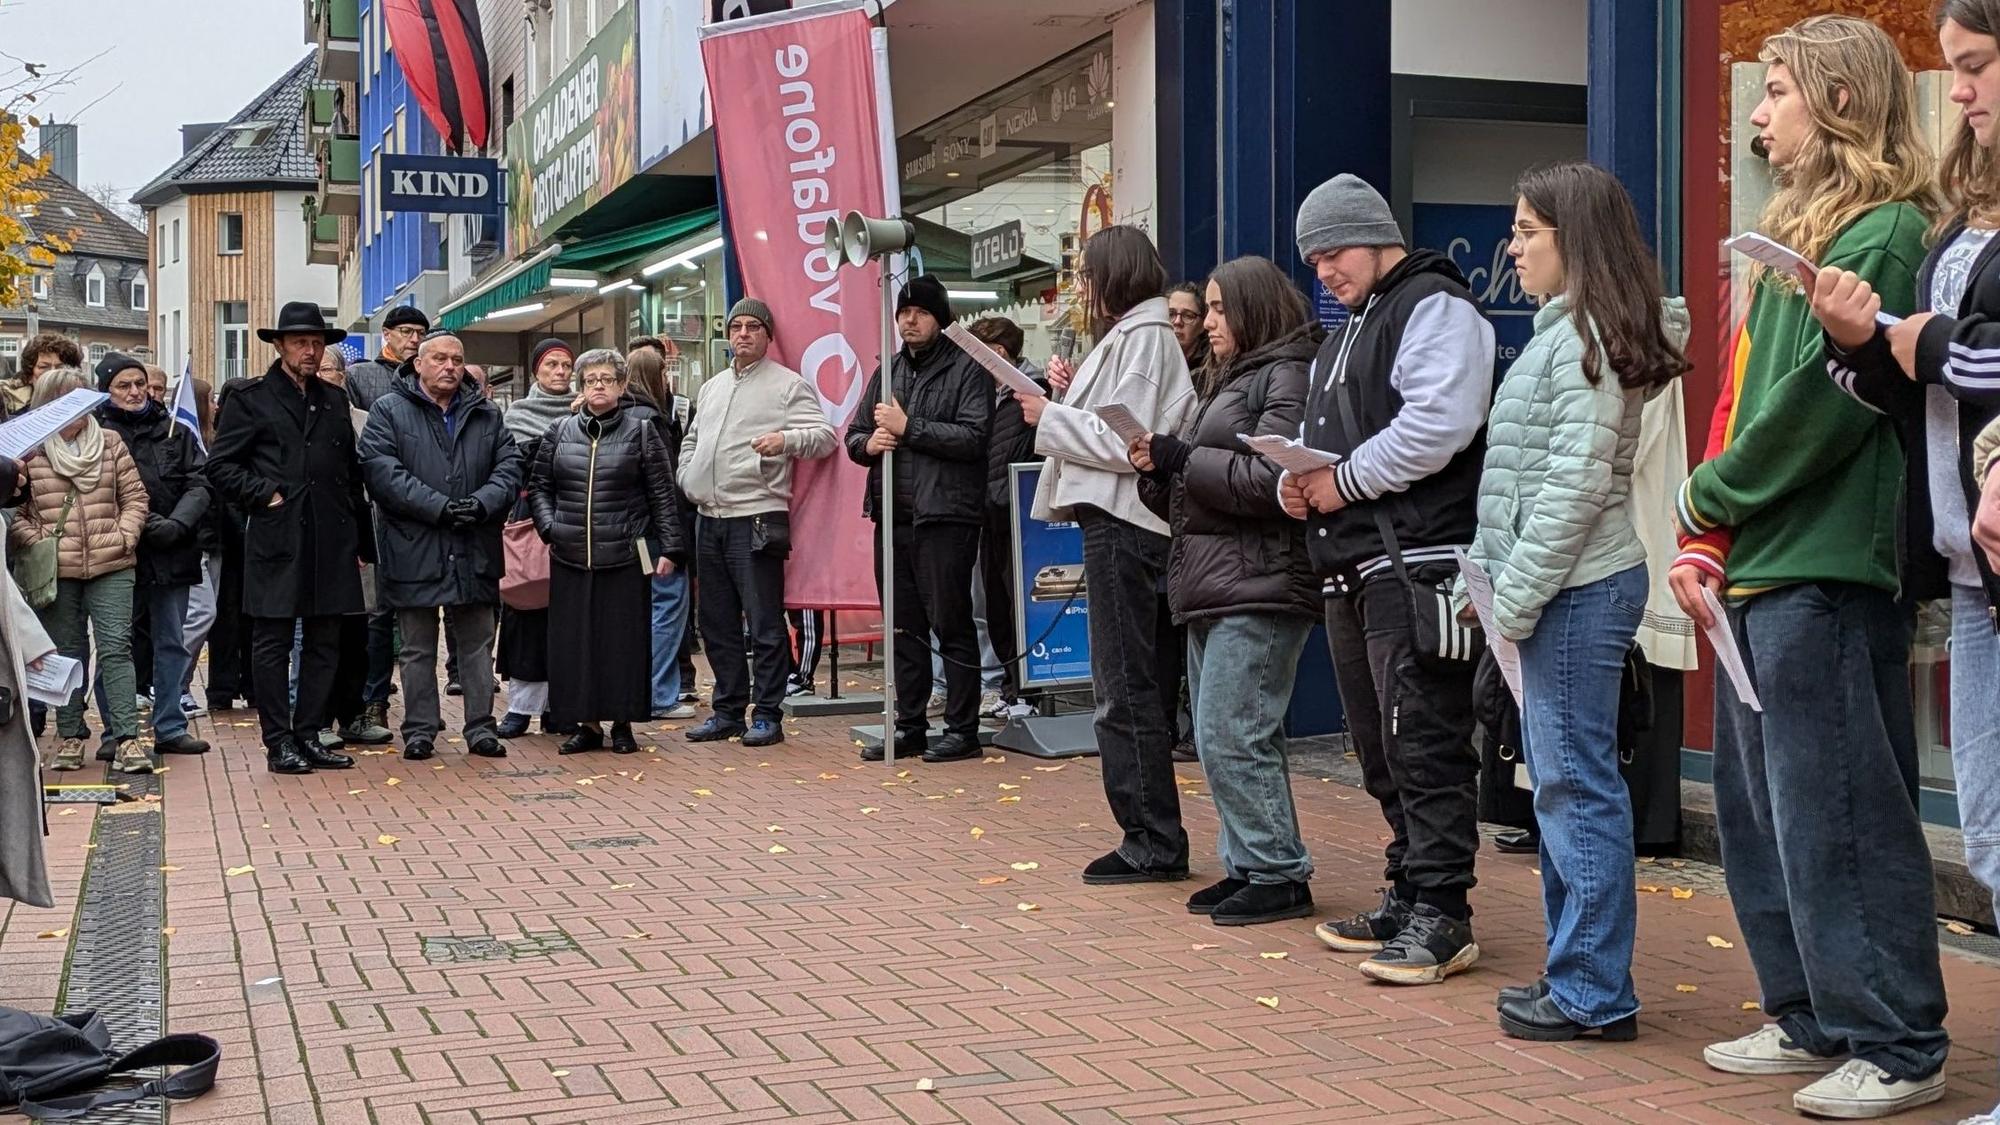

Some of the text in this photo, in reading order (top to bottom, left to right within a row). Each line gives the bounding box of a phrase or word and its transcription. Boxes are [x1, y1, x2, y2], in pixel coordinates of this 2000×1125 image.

[533, 54, 600, 165] OPLADENER
[1006, 105, 1038, 137] NOKIA
[905, 143, 935, 180] SAMSUNG
[943, 136, 970, 163] SONY
[391, 169, 489, 198] KIND
[532, 124, 600, 229] OBSTGARTEN
[1071, 606, 1088, 615] iPho
